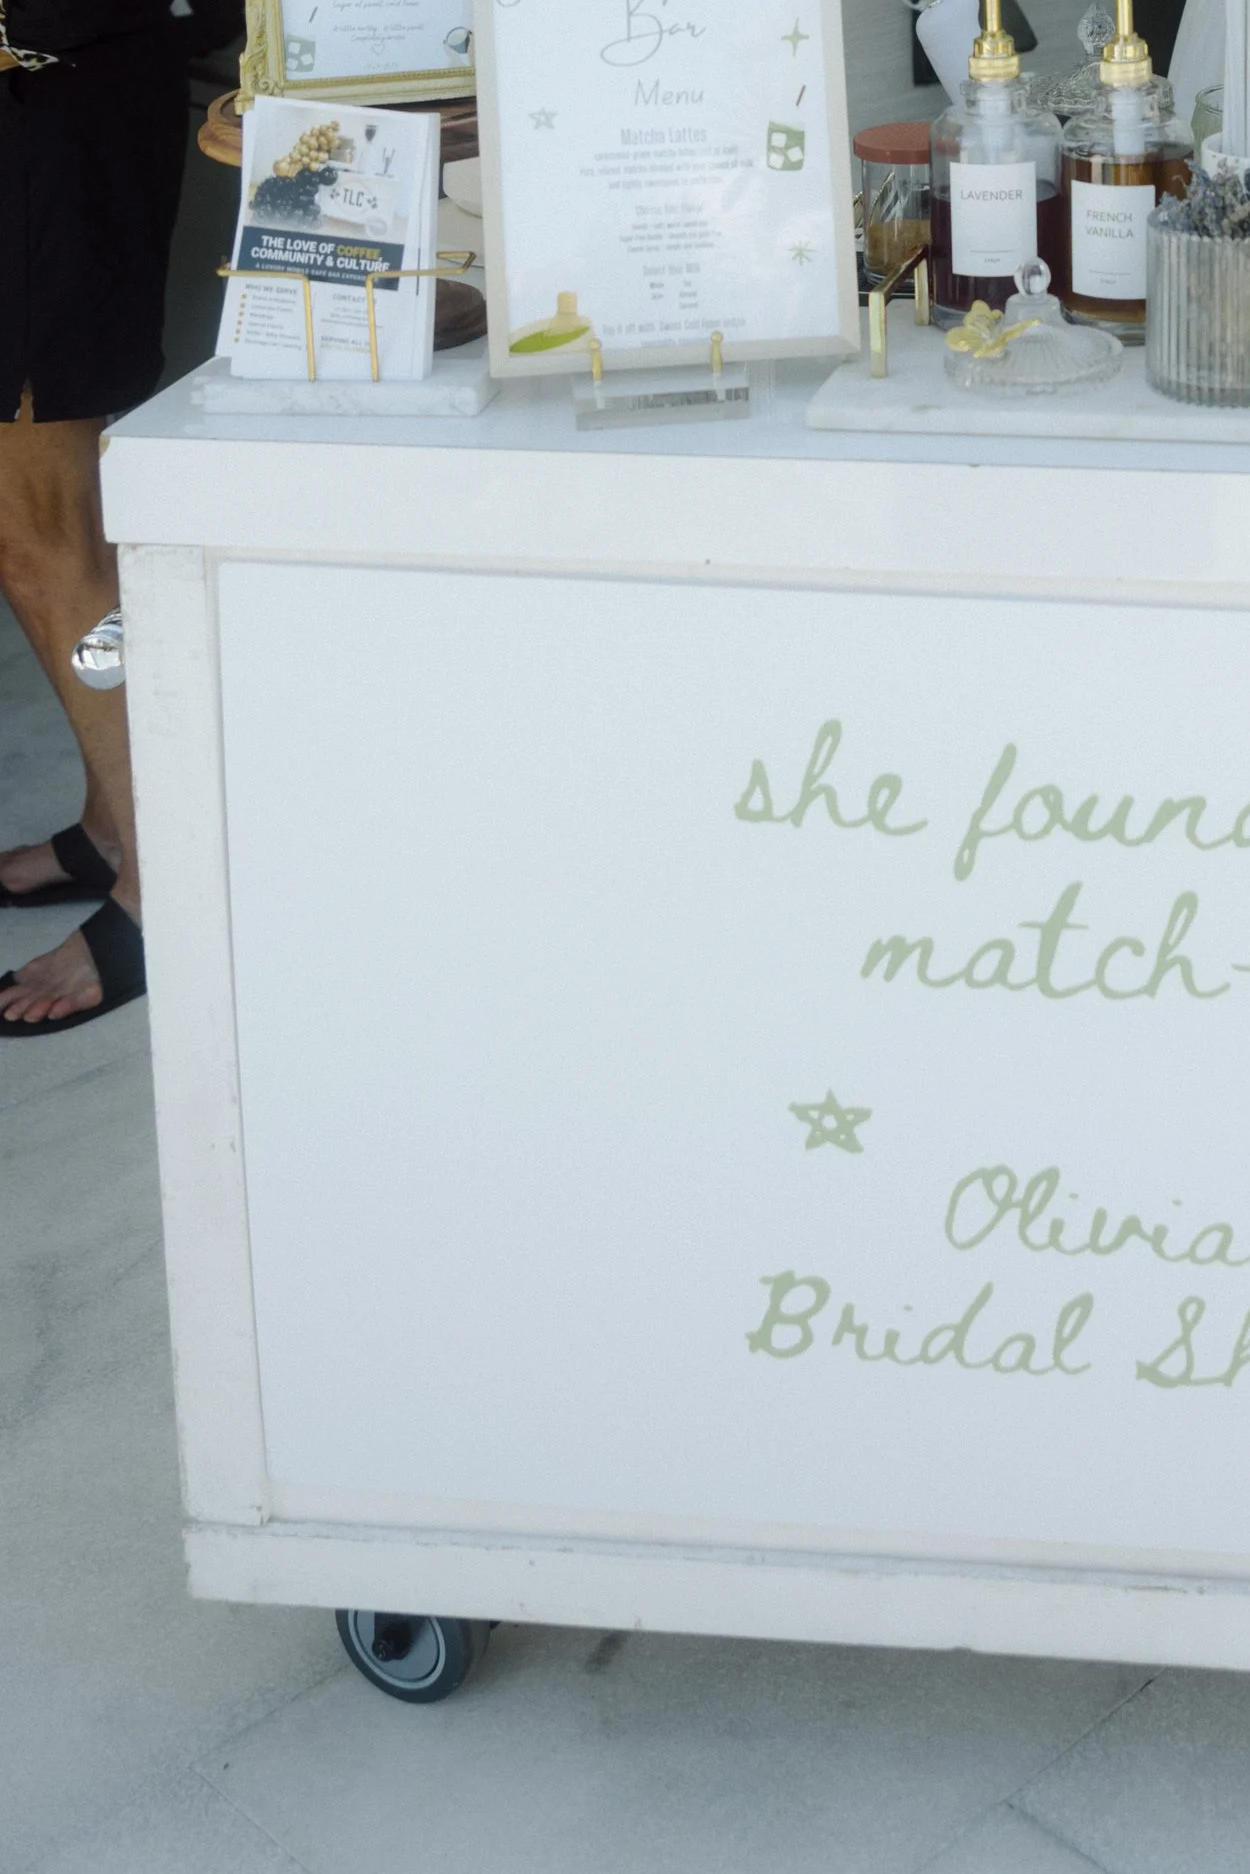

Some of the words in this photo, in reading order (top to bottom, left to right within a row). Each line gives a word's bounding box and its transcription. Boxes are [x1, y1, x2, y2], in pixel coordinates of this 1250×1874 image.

[634, 77, 705, 106] Menu
[620, 128, 665, 146] Matcha
[668, 127, 708, 143] Lattes
[343, 187, 366, 208] TLC
[960, 189, 1023, 202] LAVENDER
[1086, 209, 1133, 223] FRENCH
[1085, 225, 1135, 239] VANILLA
[261, 235, 284, 248] THE
[286, 238, 317, 253] LOVE
[318, 242, 336, 254] OF
[250, 246, 325, 266] COMMUNITY
[326, 256, 335, 267] &
[733, 718, 929, 836] she
[744, 1268, 1094, 1376] Bridal
